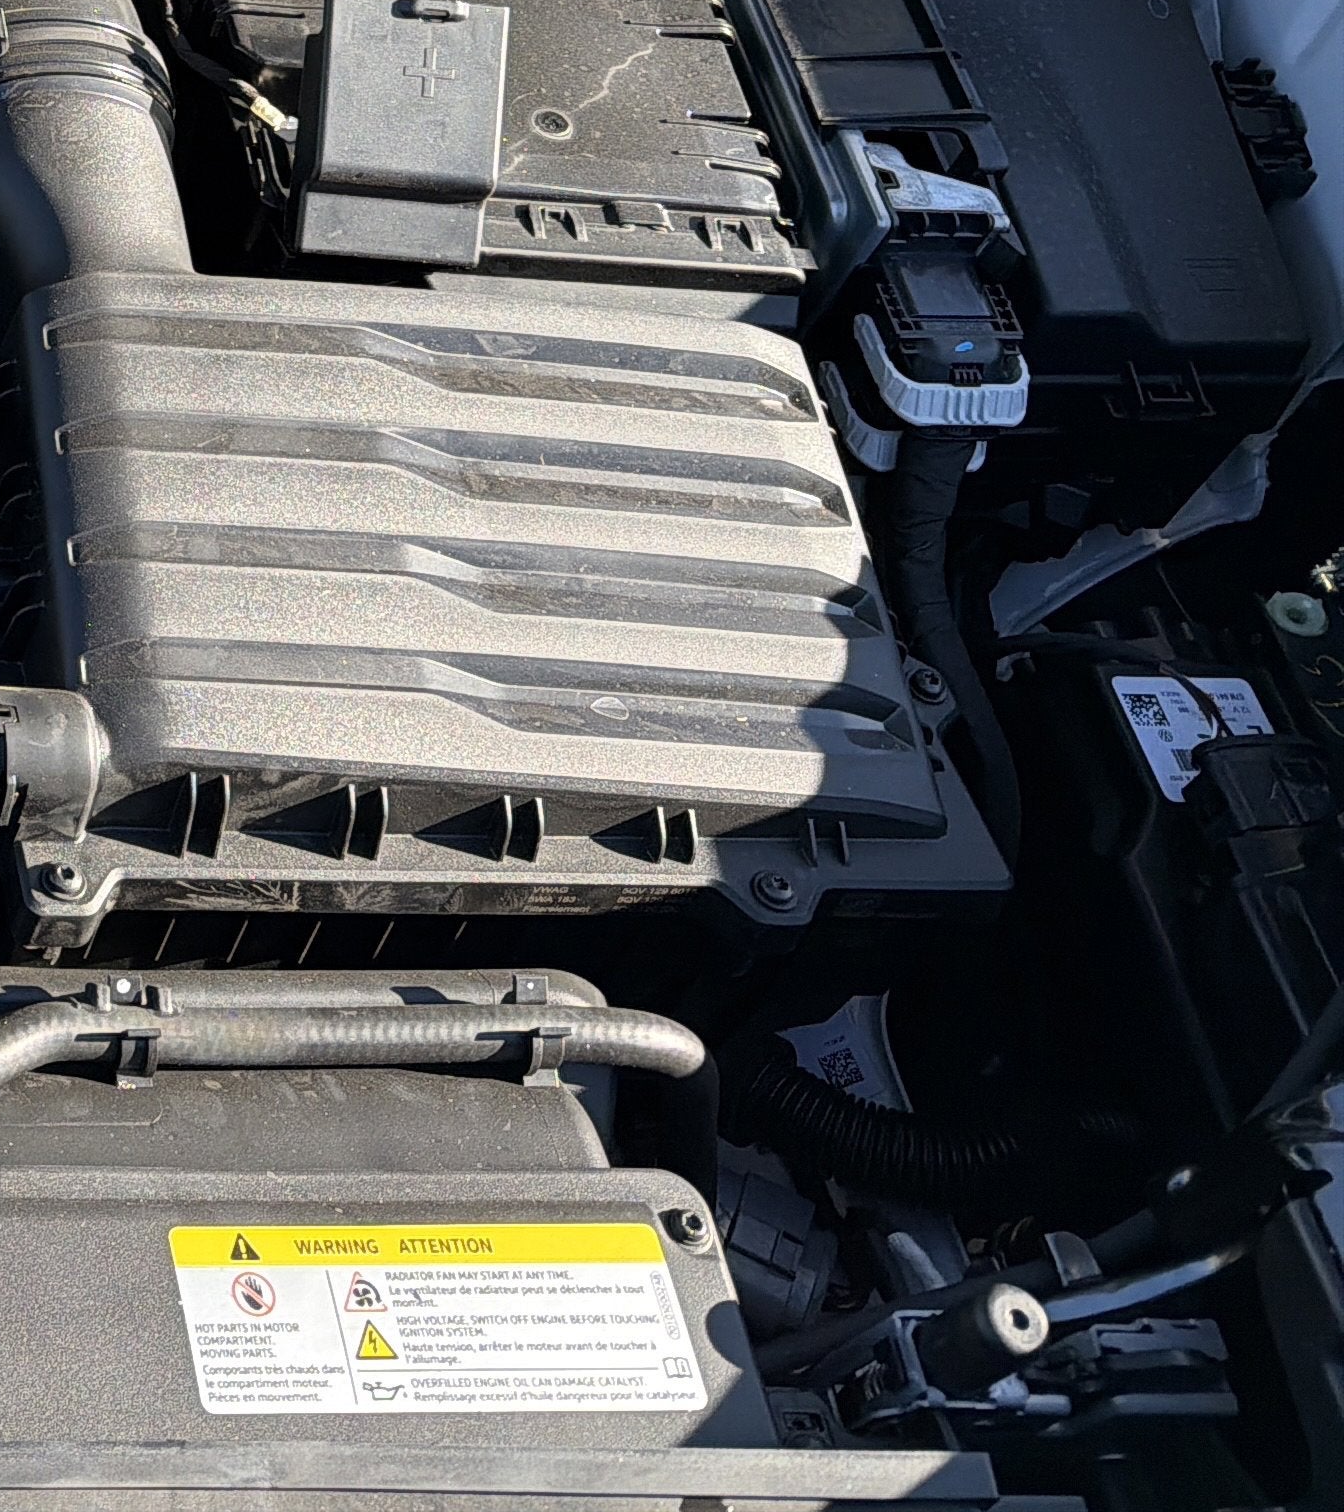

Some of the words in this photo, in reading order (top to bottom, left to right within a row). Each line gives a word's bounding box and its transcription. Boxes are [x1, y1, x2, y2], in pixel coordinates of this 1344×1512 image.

[293, 1239, 379, 1255] WARNING
[399, 1237, 494, 1254] ATTENTION
[384, 1271, 435, 1281] RADIATOR
[435, 1271, 456, 1280] FAN
[457, 1271, 478, 1280] MAY
[480, 1270, 510, 1280] START
[511, 1270, 523, 1280] AT
[525, 1270, 545, 1280] ANY
[388, 1285, 402, 1296] Le
[403, 1285, 457, 1296] ventilateur
[458, 1284, 472, 1295] de
[473, 1284, 519, 1296] radiateur
[521, 1286, 545, 1297] peut
[545, 1286, 558, 1295] se
[623, 1285, 645, 1295] tout
[396, 1315, 422, 1326] HIGH
[469, 1314, 509, 1325] SWITCH
[509, 1314, 529, 1325] OFF
[530, 1314, 569, 1325] ENGINE
[570, 1314, 609, 1325] BEFORE
[609, 1314, 660, 1325] TOUCHING
[194, 1323, 215, 1333] HOT
[217, 1322, 249, 1333] PARTS
[250, 1322, 262, 1333] IN
[263, 1322, 300, 1333] MOTOR
[398, 1327, 445, 1338] IGNITION
[445, 1326, 488, 1337] SYSTEM.
[196, 1335, 277, 1346] COMPARTMENT.
[402, 1342, 434, 1353] Haute
[477, 1340, 513, 1352] arrêter
[514, 1341, 524, 1352] le
[526, 1342, 563, 1351] moteur
[565, 1342, 593, 1351] avant
[595, 1341, 608, 1351] de
[609, 1341, 648, 1351] toucher
[199, 1348, 241, 1359] MOVING
[242, 1347, 278, 1358] PARTS.
[202, 1364, 264, 1377] Composants
[265, 1363, 284, 1375] très
[285, 1363, 320, 1375] chauds
[321, 1363, 345, 1375] dans
[204, 1378, 215, 1389] le
[217, 1377, 290, 1390] compartiment
[410, 1378, 471, 1389] OVERFILLED
[473, 1377, 511, 1388] ENGINE
[512, 1377, 529, 1388] OIL
[530, 1377, 553, 1388] CAN
[554, 1376, 596, 1387] DAMAGE
[207, 1391, 240, 1403] Pièces
[242, 1393, 256, 1402] en
[413, 1391, 478, 1404] Remplissage
[556, 1391, 608, 1404] dangereux
[610, 1392, 632, 1402] pour
[634, 1390, 644, 1400] le
